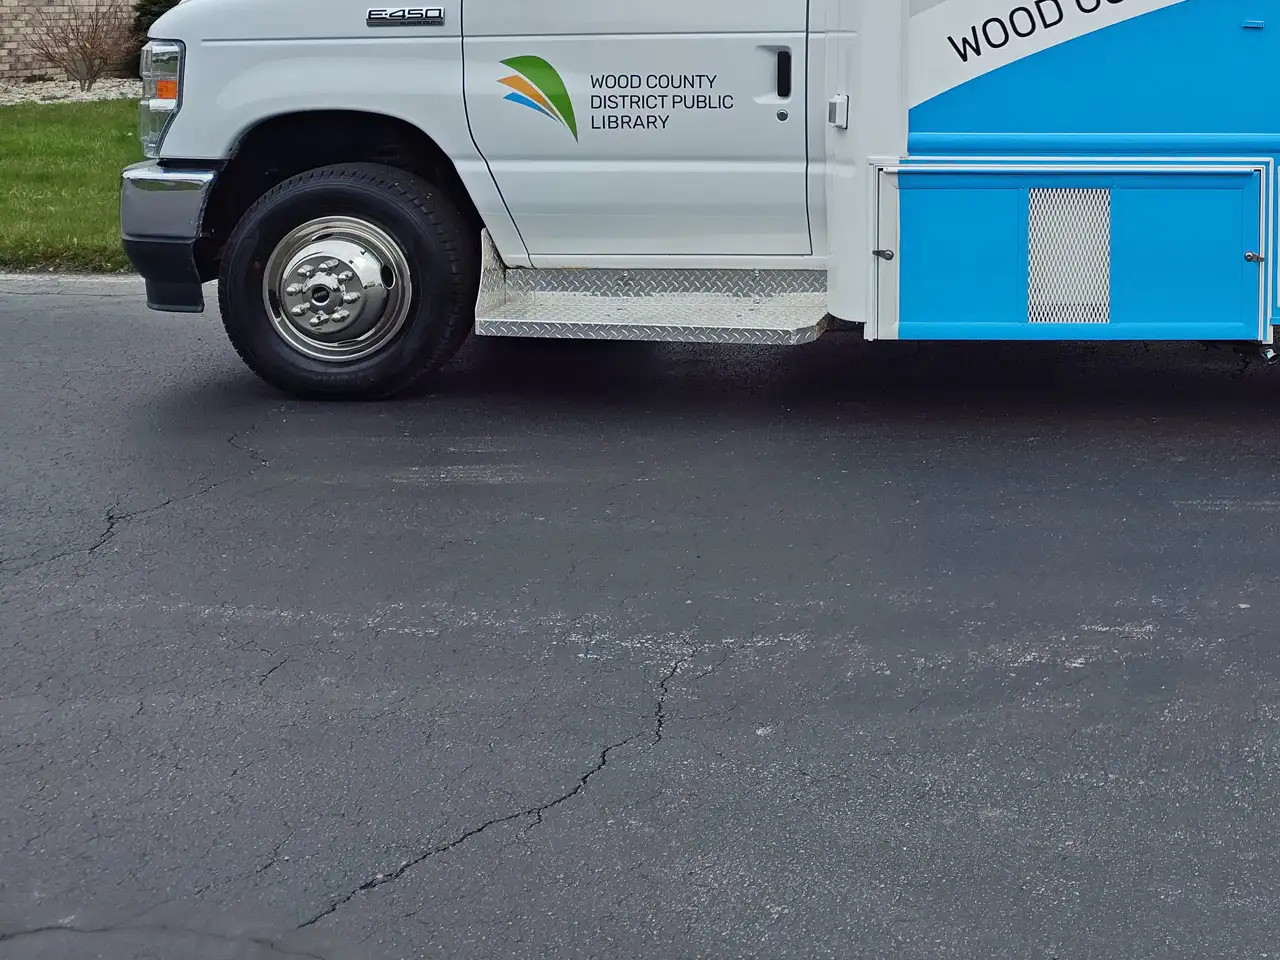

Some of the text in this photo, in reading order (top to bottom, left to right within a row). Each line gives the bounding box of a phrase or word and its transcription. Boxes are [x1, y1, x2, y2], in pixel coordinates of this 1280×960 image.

[590, 74, 717, 89] WOOD COUNTY
[590, 94, 734, 110] DISTRICT PUBLIC
[591, 114, 670, 130] LIBRARY
